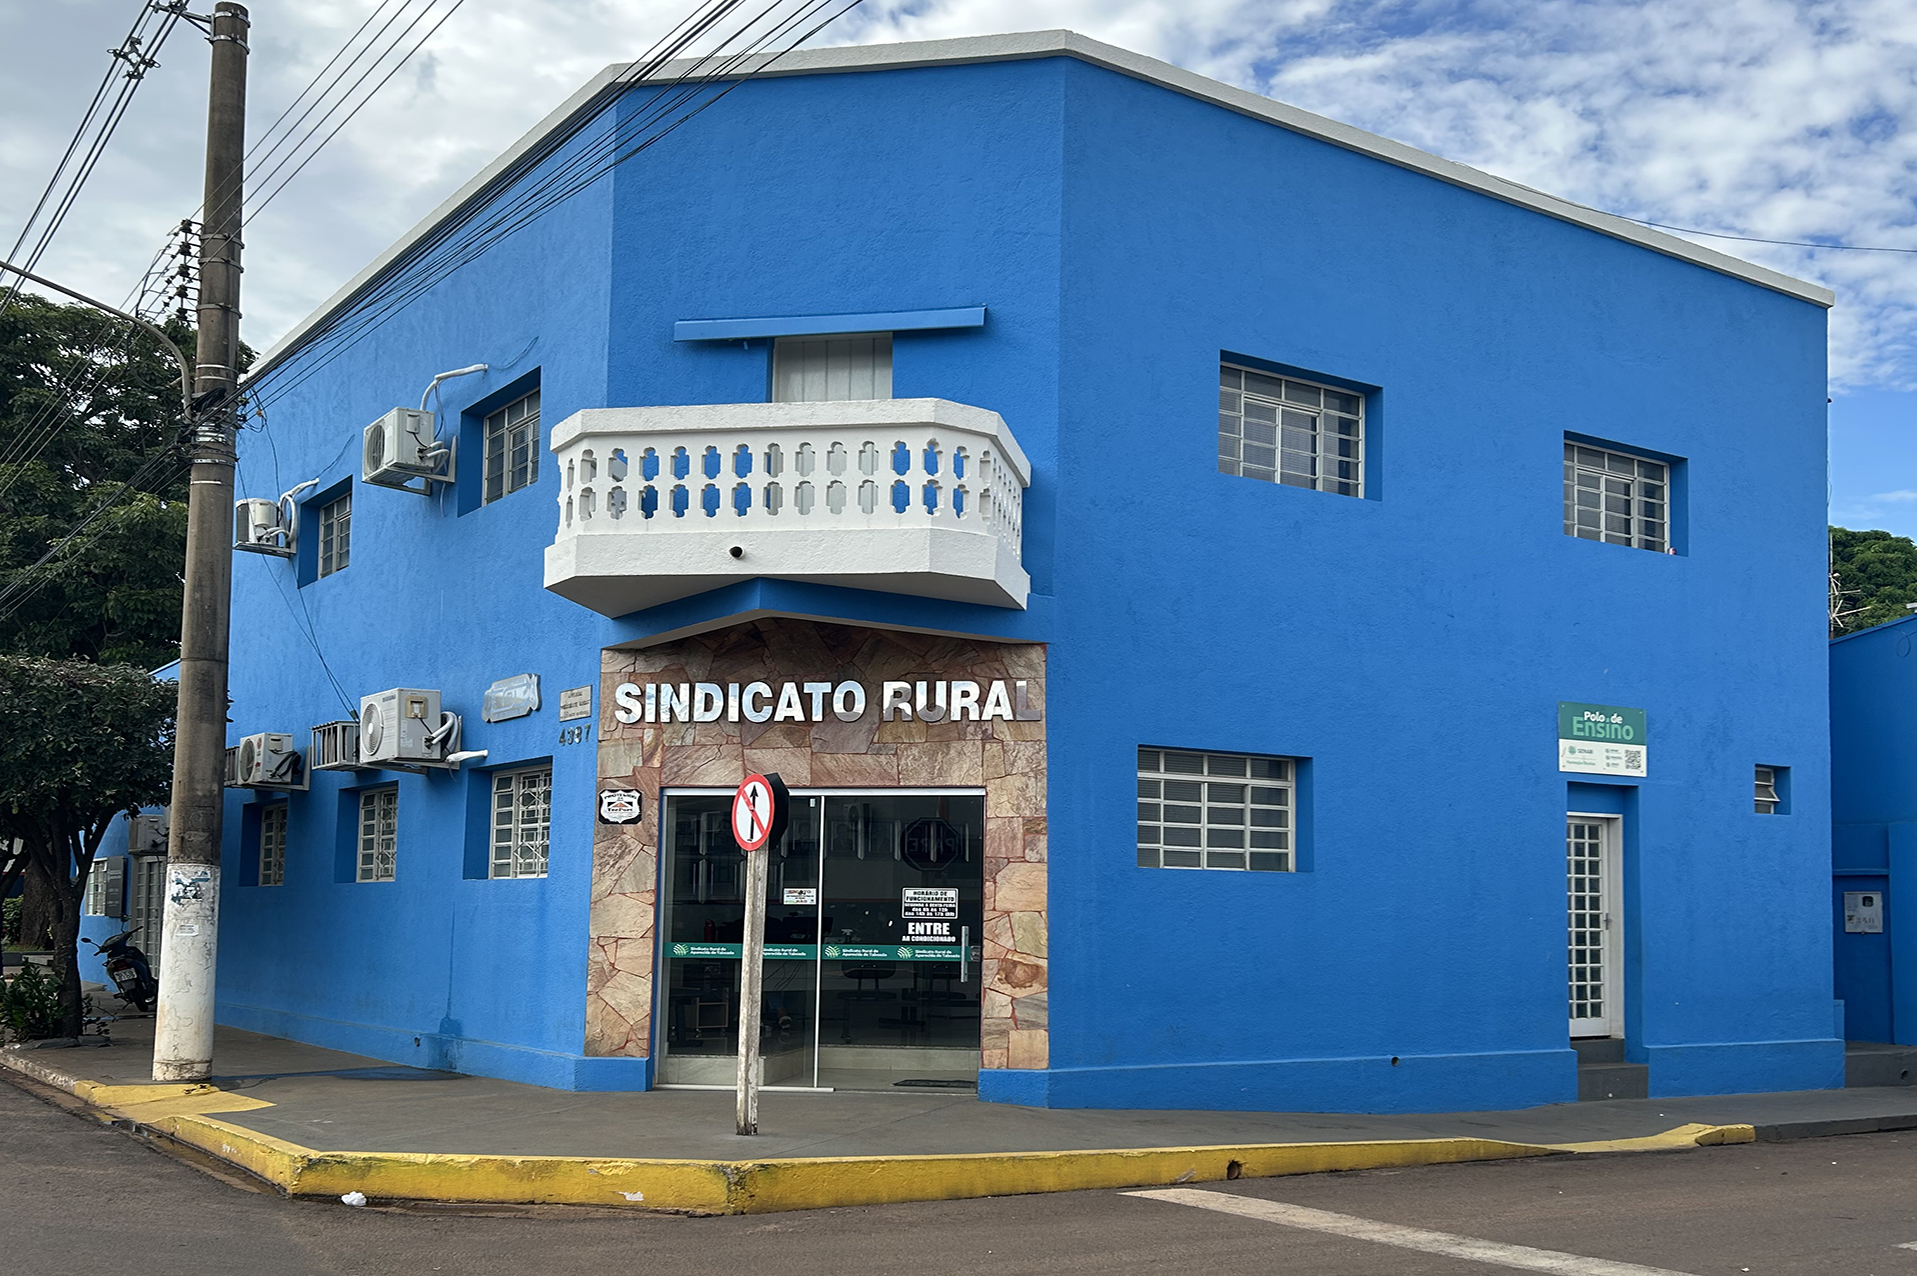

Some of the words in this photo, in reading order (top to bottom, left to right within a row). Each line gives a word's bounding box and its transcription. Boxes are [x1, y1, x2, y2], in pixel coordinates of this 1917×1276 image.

[614, 681, 867, 725] SINDICATO
[882, 680, 1042, 723] RURAL
[1583, 711, 1605, 722] Polo
[1610, 713, 1623, 724] de
[1572, 716, 1634, 740] Ensino
[908, 922, 950, 935] ENTRE
